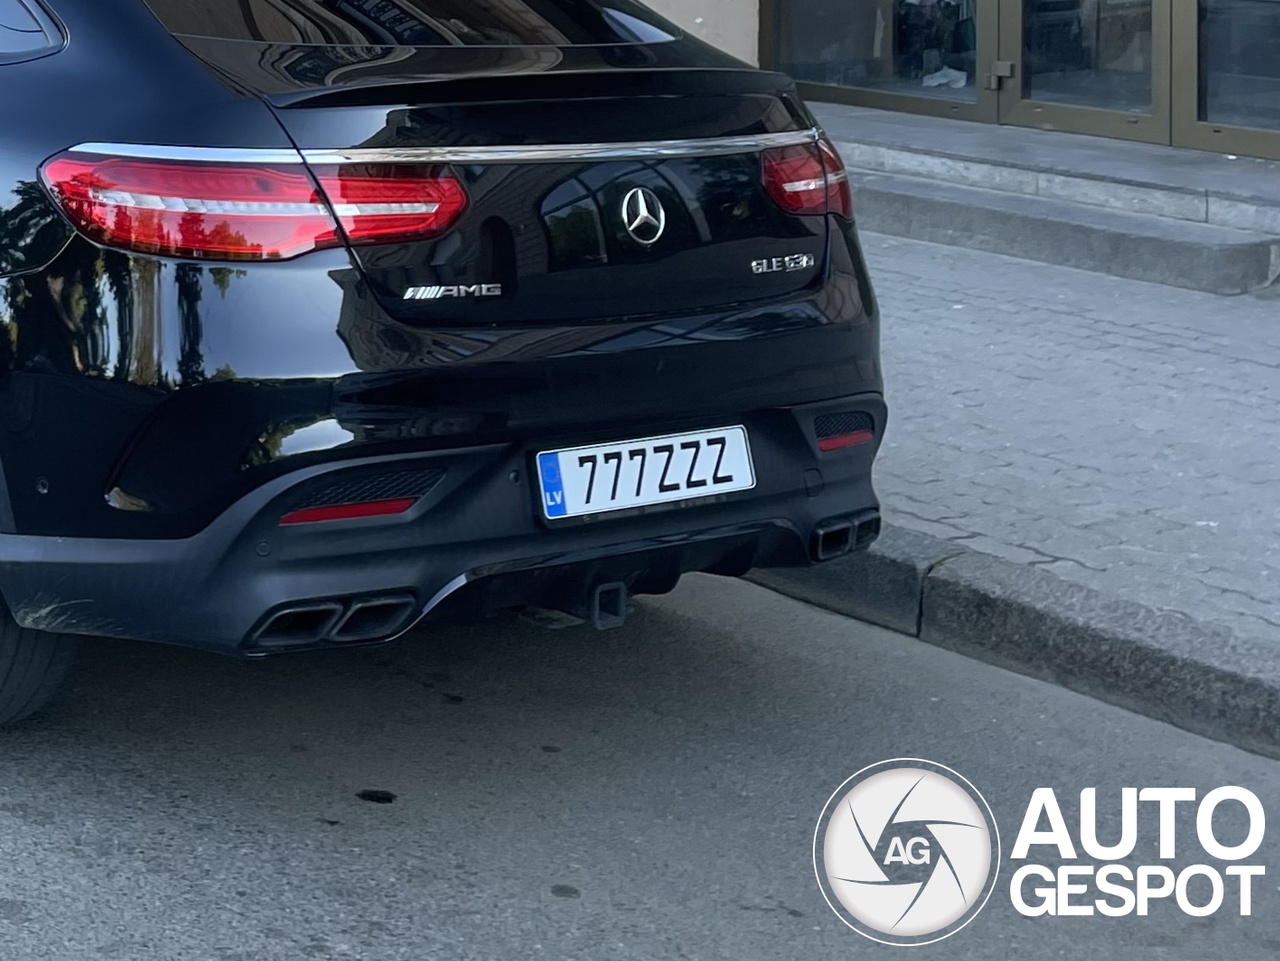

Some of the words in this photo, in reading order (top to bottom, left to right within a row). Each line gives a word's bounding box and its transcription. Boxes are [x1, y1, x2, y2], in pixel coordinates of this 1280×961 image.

[751, 258, 783, 273] GLE
[578, 436, 734, 505] 777ZZZ
[546, 490, 563, 506] LV
